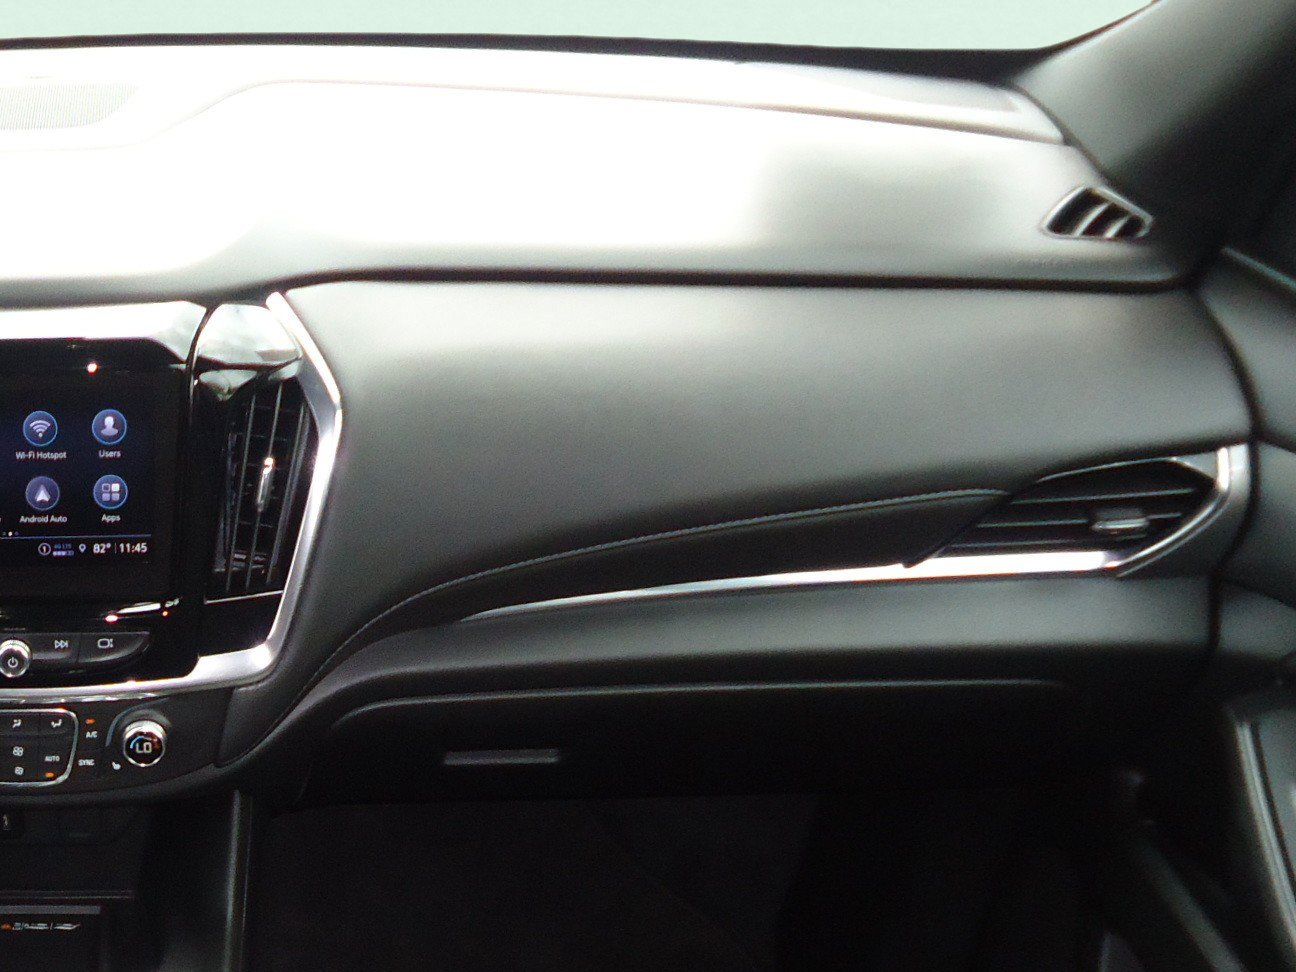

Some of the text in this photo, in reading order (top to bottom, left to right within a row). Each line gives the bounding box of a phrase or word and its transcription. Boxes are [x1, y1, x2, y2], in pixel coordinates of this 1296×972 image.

[15, 451, 67, 460] Wi-Fi Hotspot
[98, 449, 122, 458] Users
[19, 514, 68, 524] Android Auto
[101, 513, 121, 524] Apps
[119, 542, 148, 554] 11:45
[85, 730, 98, 739] A/C
[78, 758, 95, 767] SYNC
